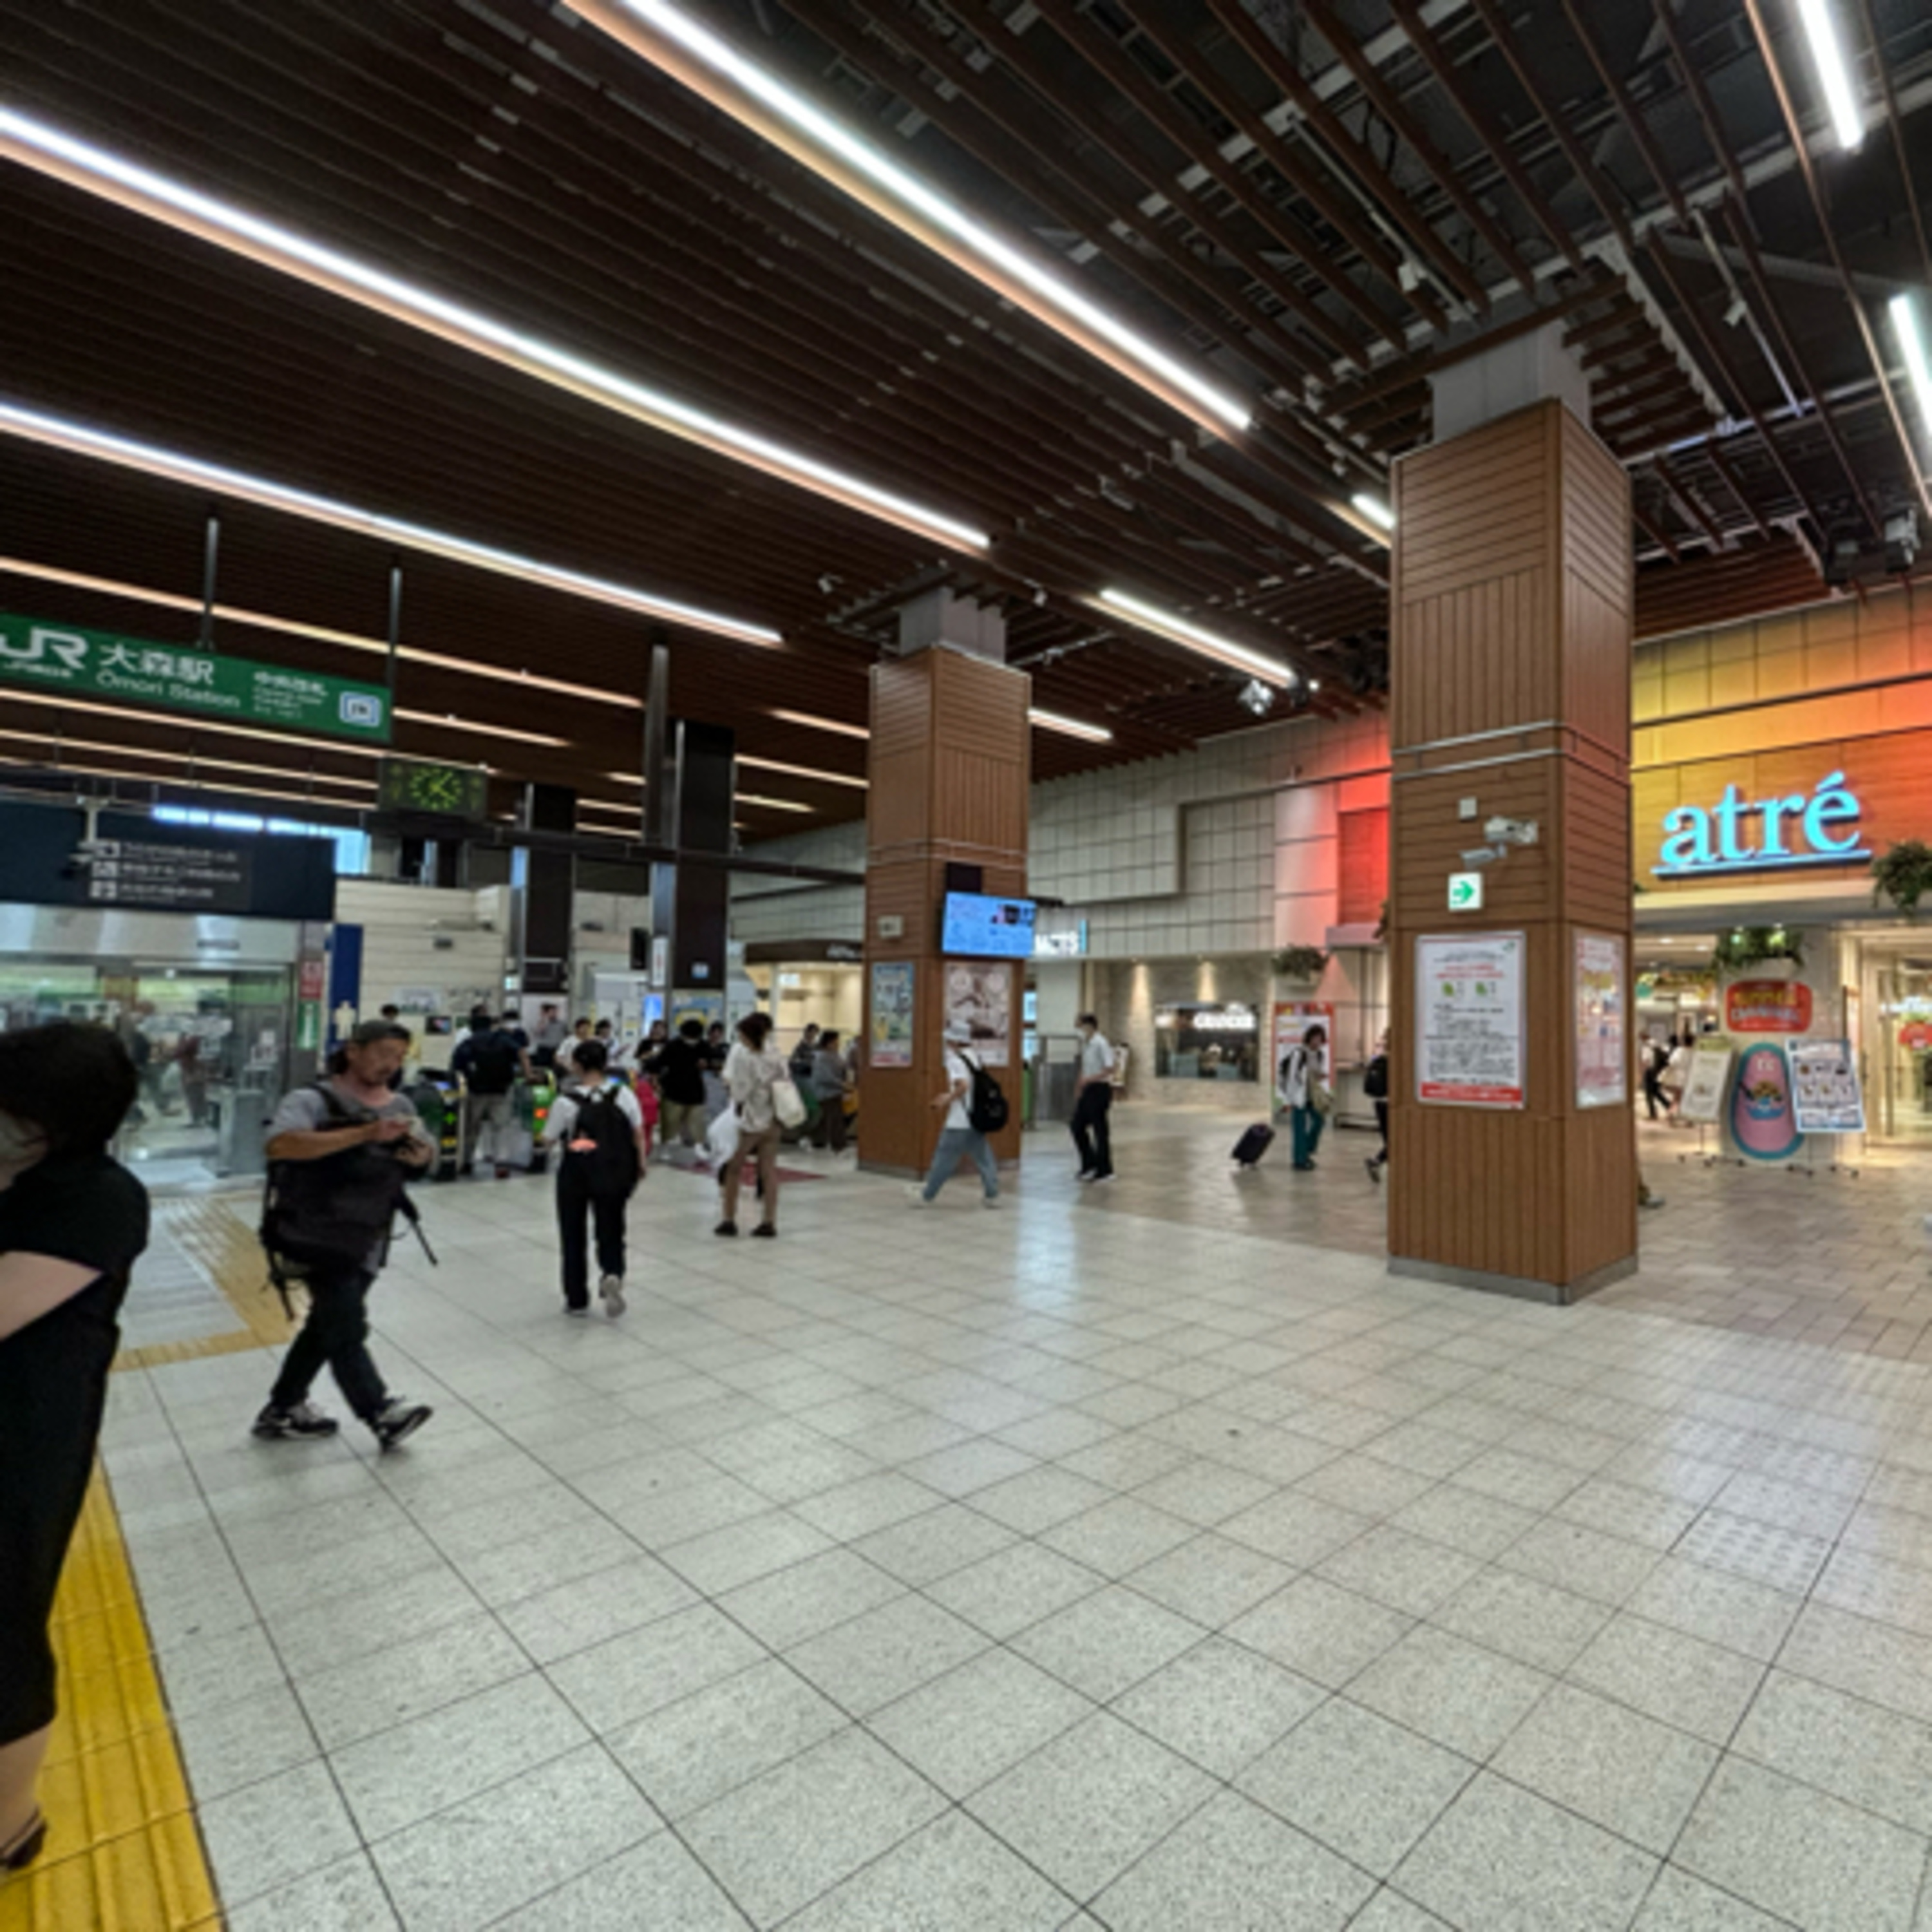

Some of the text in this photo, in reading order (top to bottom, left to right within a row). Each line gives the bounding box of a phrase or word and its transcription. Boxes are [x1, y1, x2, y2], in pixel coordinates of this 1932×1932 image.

[0, 627, 89, 669] JR
[99, 643, 214, 685] 大森駅
[96, 668, 162, 696] Omori
[169, 683, 241, 708] Station
[1660, 769, 1862, 866] atré
